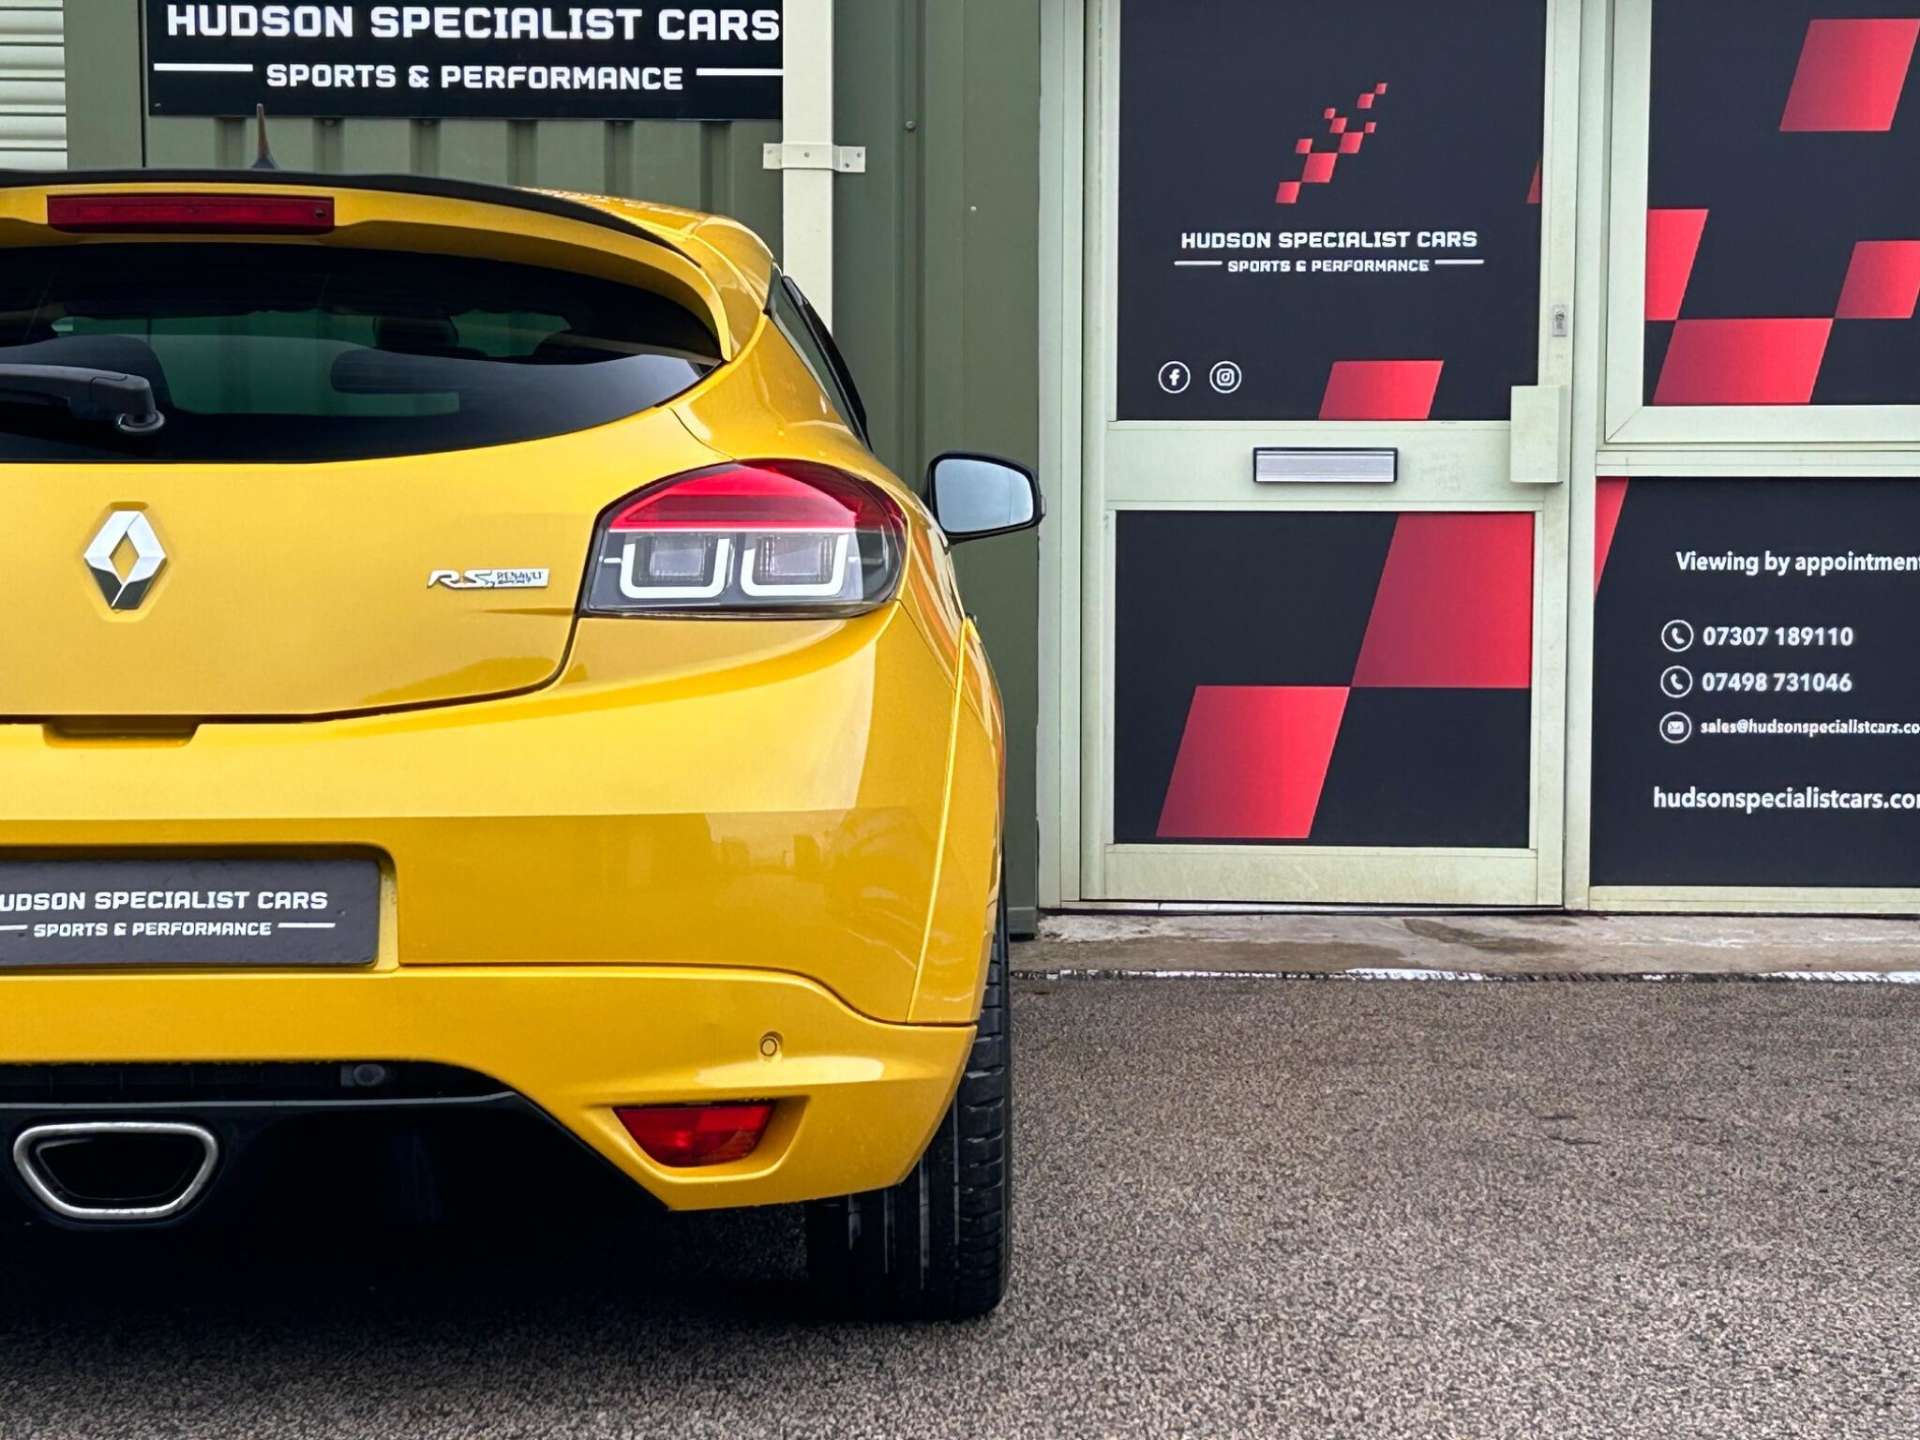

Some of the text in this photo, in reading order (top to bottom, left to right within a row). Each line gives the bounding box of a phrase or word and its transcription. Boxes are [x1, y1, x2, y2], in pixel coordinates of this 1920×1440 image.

[167, 4, 781, 42] HUDSON SPECIALIST CARS
[266, 63, 684, 91] SPORTS & PERFORMANCE
[1181, 231, 1478, 249] HUDSON SPECIALIST CARS
[1227, 259, 1430, 273] SPORTS & PERFORMANCE
[1676, 550, 1920, 576] Viewing by appointmen
[1703, 626, 1854, 646] 07307 189110
[1702, 672, 1852, 692] 07498 731046
[1700, 718, 1920, 737] sales@hudsonspecialistcars.co
[1653, 786, 1920, 814] hudsonspecialistcars.co
[0, 890, 328, 912] UDSON SPECIALIST CARS
[33, 921, 272, 938] SPORTS & PERFORMANCE
